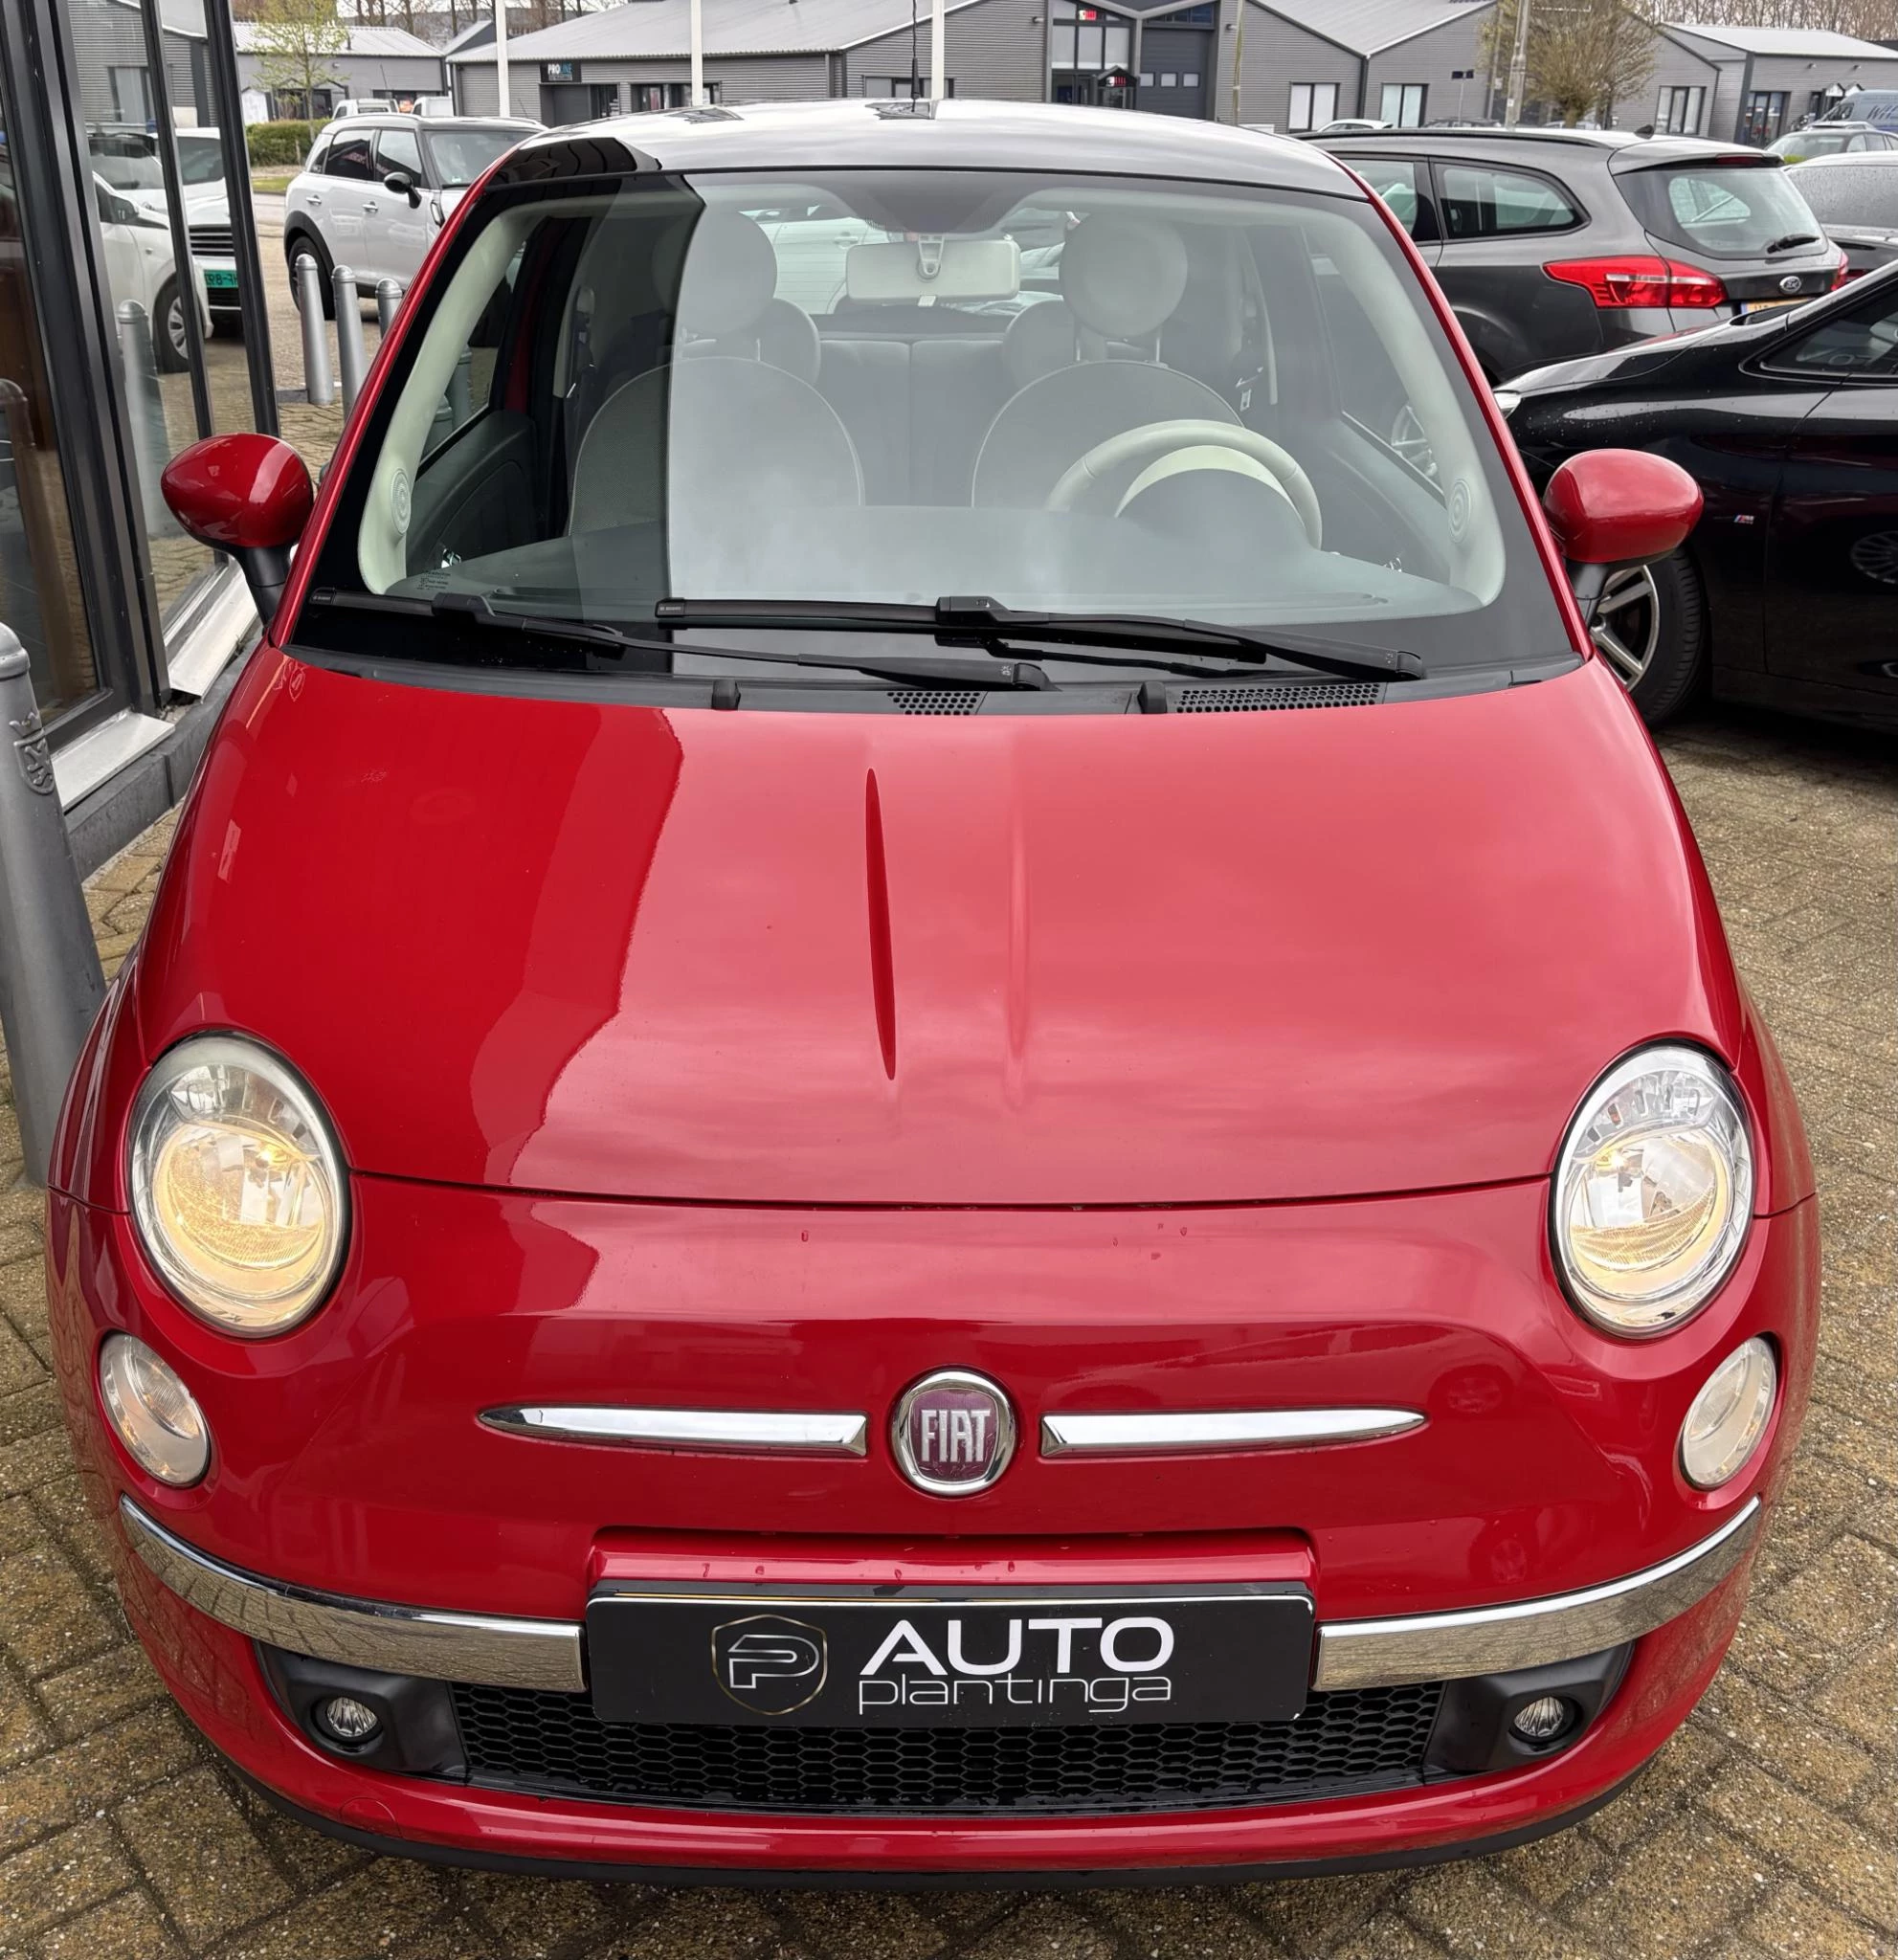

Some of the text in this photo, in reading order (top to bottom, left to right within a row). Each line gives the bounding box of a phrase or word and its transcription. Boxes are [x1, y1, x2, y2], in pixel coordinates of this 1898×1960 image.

[920, 1409, 991, 1462] FIAT
[860, 1616, 1174, 1676] AUTO
[859, 1673, 1172, 1716] plantinga
